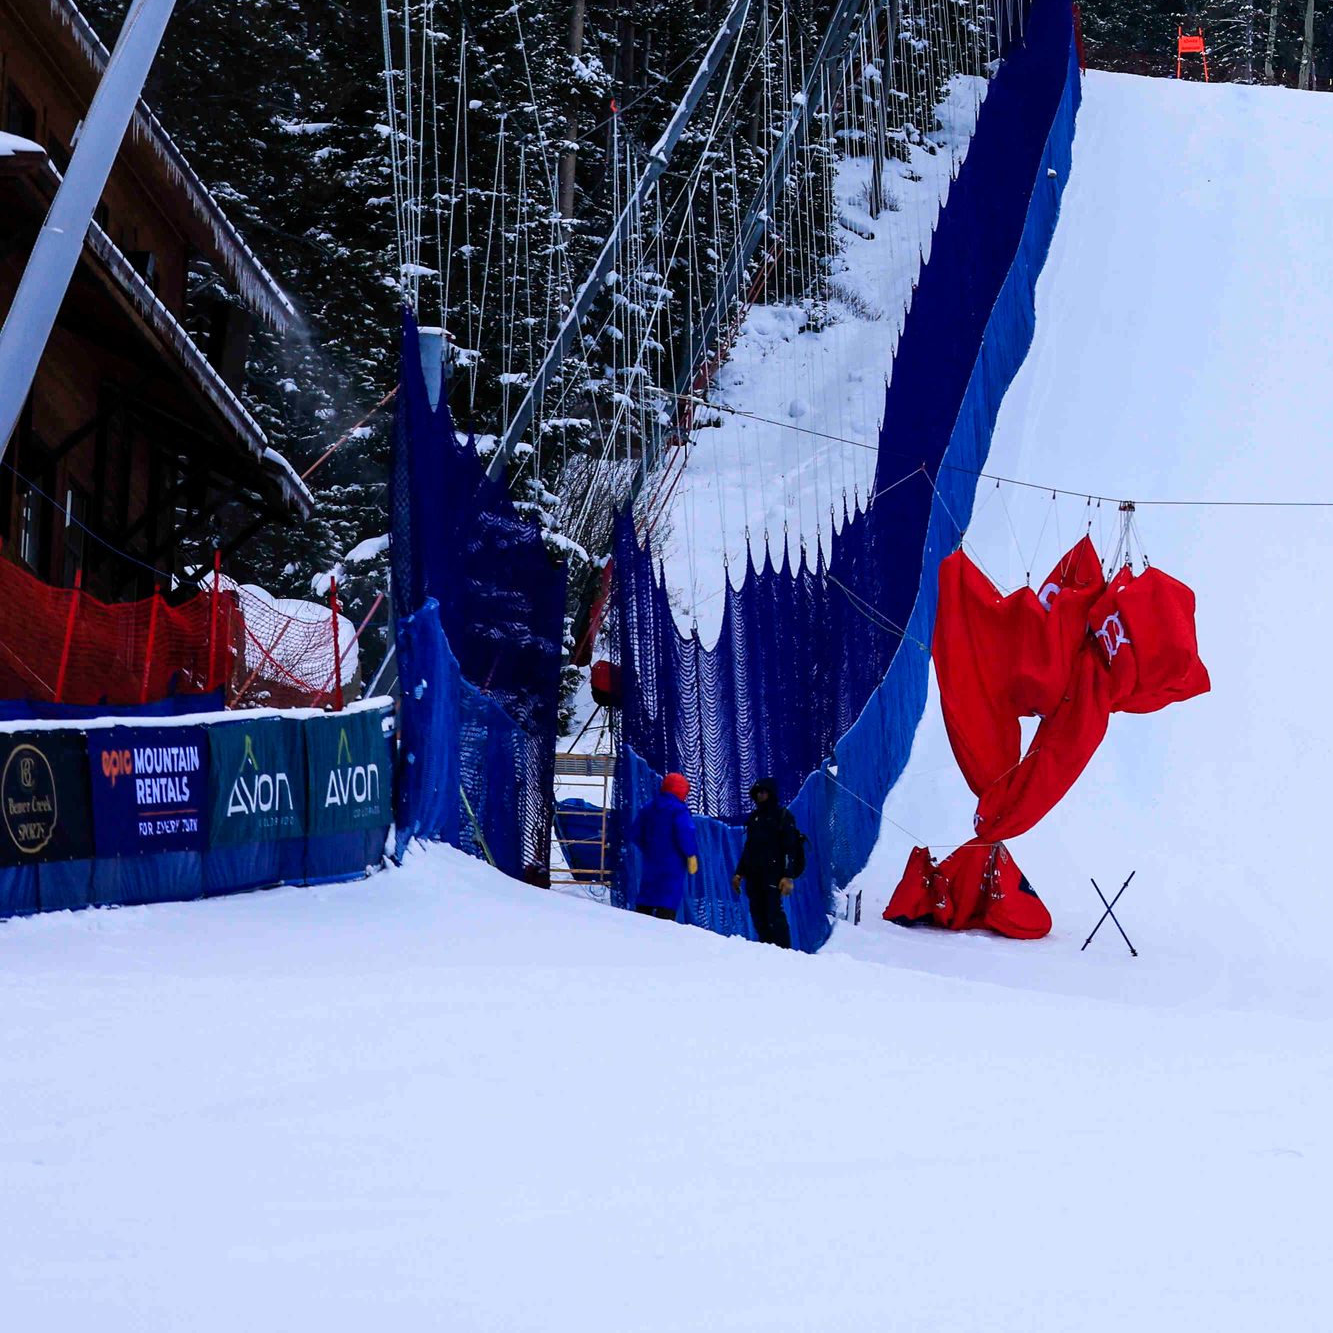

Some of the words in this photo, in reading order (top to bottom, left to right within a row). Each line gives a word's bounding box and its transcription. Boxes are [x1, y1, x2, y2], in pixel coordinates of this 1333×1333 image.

[134, 746, 199, 774] MOUNTAIN
[136, 776, 190, 804] RENTALS
[139, 822, 153, 836] FOR
